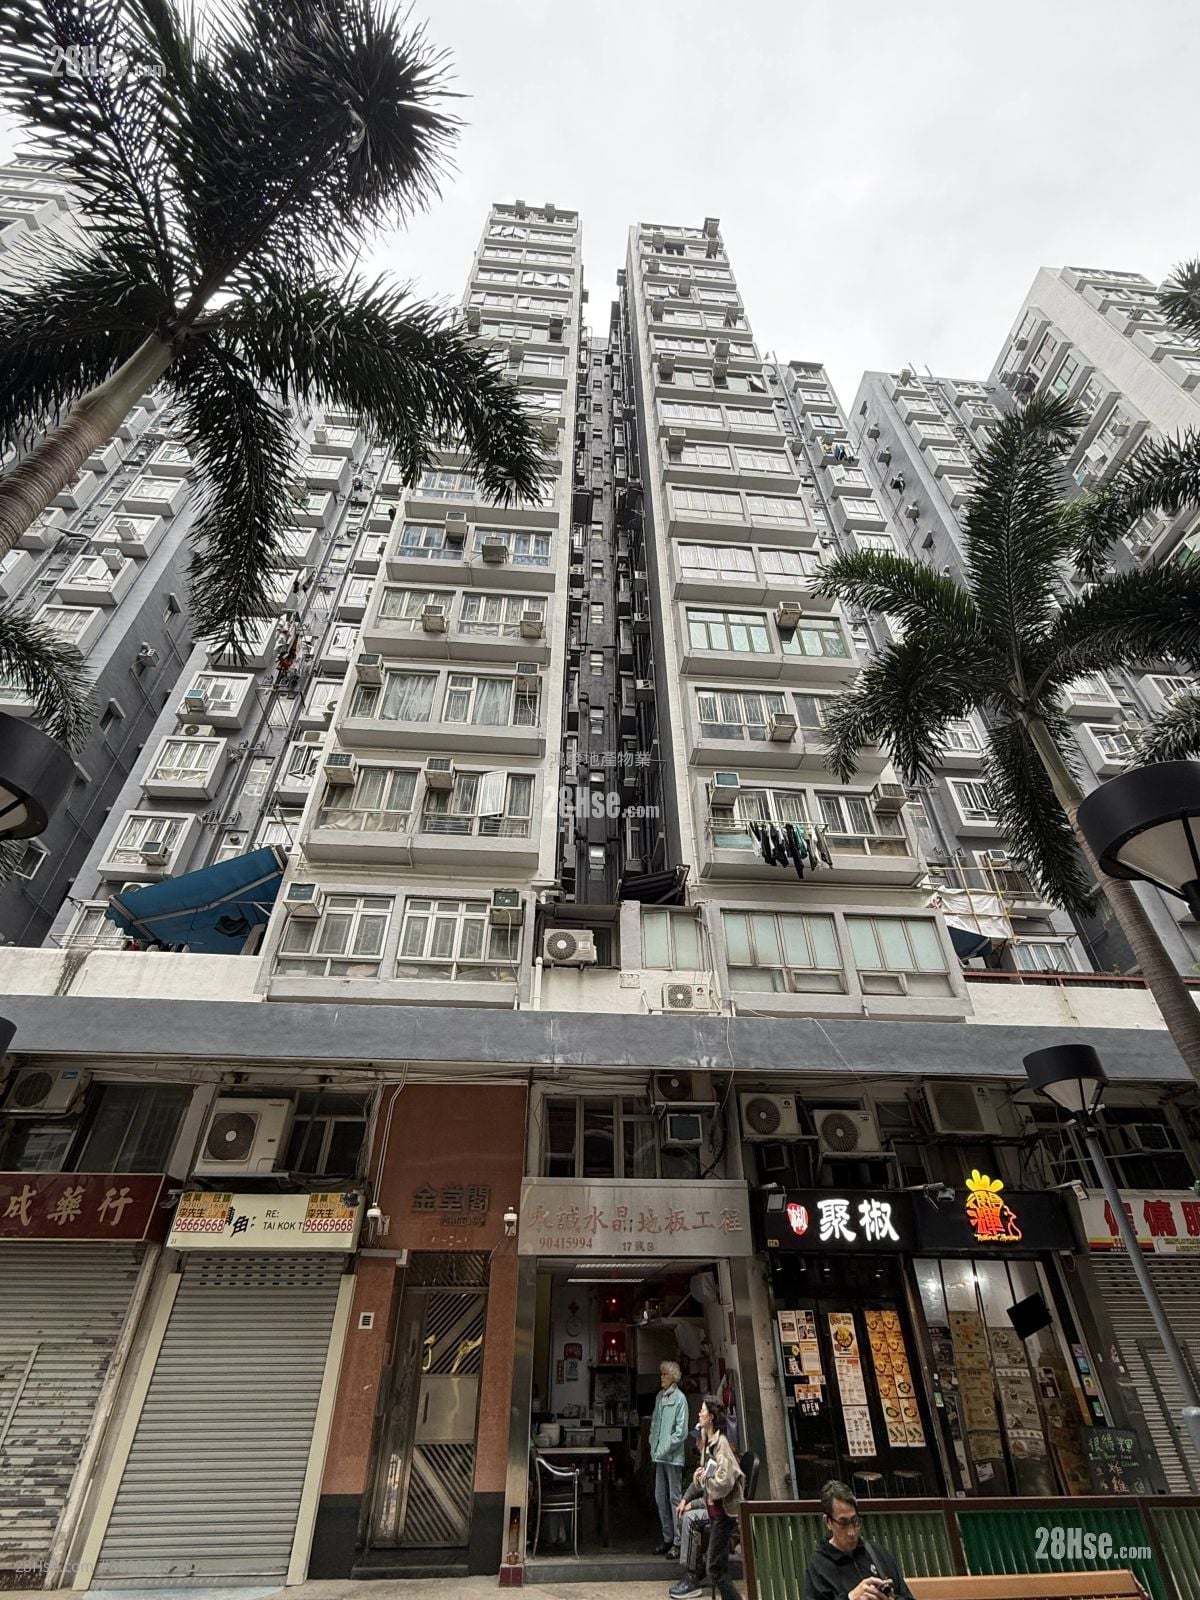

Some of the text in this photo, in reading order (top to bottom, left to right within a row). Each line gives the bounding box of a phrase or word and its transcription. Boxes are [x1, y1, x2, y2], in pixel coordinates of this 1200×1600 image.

[2, 1184, 134, 1227] 成藥行
[265, 1209, 280, 1218] RE:
[174, 1218, 225, 1231] 96669668
[263, 1221, 275, 1230] TAI
[277, 1221, 297, 1230] KOK
[305, 1218, 353, 1231] 96669668
[817, 1198, 900, 1242] 聚椒
[538, 1237, 593, 1249] 90415994
[801, 1402, 820, 1413] OPEN
